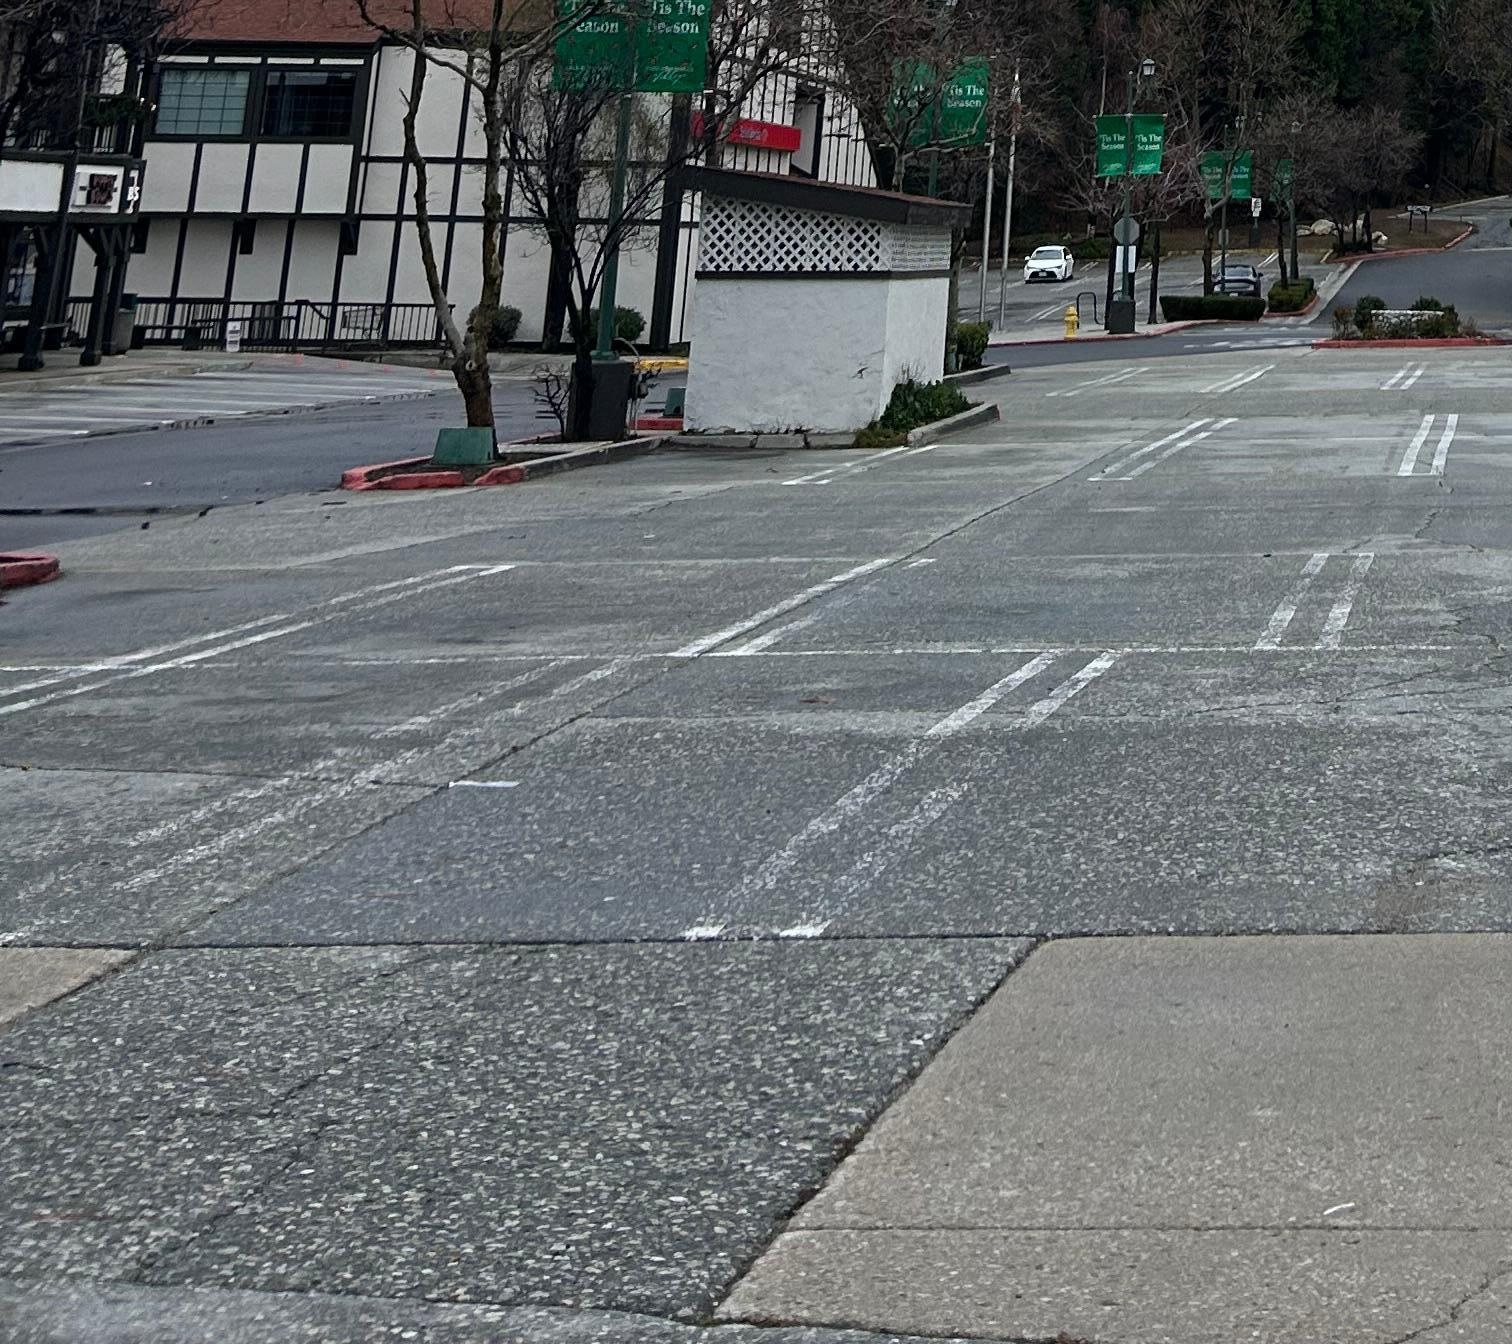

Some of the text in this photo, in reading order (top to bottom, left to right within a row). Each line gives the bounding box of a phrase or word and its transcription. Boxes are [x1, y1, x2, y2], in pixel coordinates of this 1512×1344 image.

[675, 0, 706, 17] The
[965, 84, 985, 96] The
[1112, 133, 1126, 142] The
[1149, 133, 1162, 142] The
